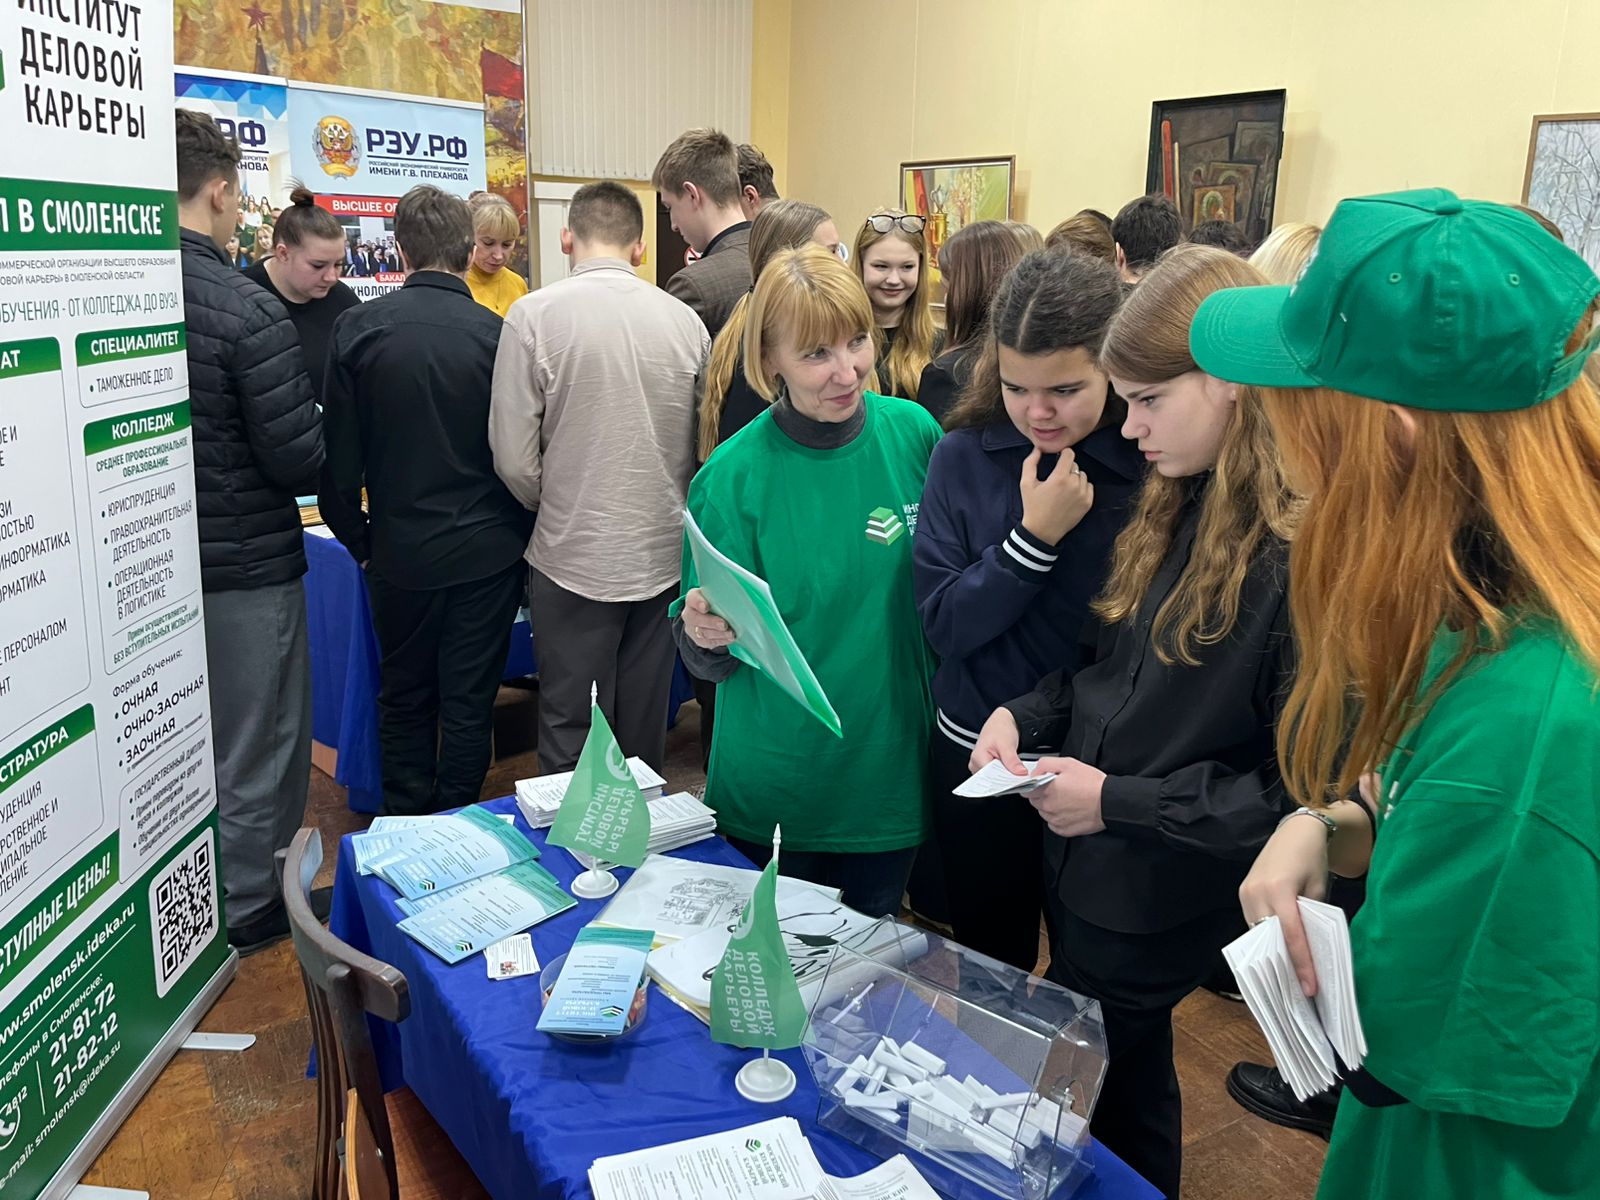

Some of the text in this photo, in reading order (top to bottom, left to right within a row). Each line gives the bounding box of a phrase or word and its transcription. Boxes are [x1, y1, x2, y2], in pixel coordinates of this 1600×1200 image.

[18, 0, 141, 41] СТИТУТ
[20, 26, 143, 91] ДЕЛОВОЙ
[24, 83, 145, 139] КАРЬЕРЫ
[366, 128, 468, 160] РЭУ.РФ
[369, 166, 469, 181] ИМЕНИ Г.В. ПЛЕХАНОВА
[18, 198, 35, 232] В
[332, 200, 383, 212] ВЫСШЕЕ
[57, 258, 103, 268] ОРГАНИЗАЦИИ
[104, 257, 137, 267] ВЫСШЕГО
[137, 257, 177, 266] ОБРАЗОВАНИЯ
[65, 272, 69, 283] В
[70, 270, 113, 282] СМОЛЕНСКОЙ
[114, 270, 145, 280] ОБЛАСТИ
[0, 299, 60, 324] БУЧЕНИЯ
[68, 298, 81, 318] ОТ
[83, 294, 142, 316] КОЛЛЕДЖА
[143, 292, 158, 314] ДО
[159, 291, 179, 310] ВУЗА
[91, 330, 179, 356] СПЕЦИАЛИТЕТ
[96, 366, 173, 393] ТАМОЖЕННОЕ ДЕЛО
[111, 412, 175, 440] КОЛЛЕДЖ
[96, 436, 188, 472] СРЕДНЕЕ ПРОФЕССИОНАЛЬНОЕ
[122, 456, 169, 477] ОБРАЗОВАНИЕ
[108, 482, 176, 517] ЮРИСПРУДЕНЦИЯ
[0, 514, 34, 541] ОСТЬЮ
[110, 500, 192, 543] ПРАВООХРАНИТЕЛЬНАЯ
[113, 527, 171, 564] ДЕЯТЕЛЬНОСТЬ
[114, 549, 174, 586] ОПЕРАЦИОННАЯ
[117, 567, 174, 606] ДЕЯТЕЛЬНОСТЬ
[117, 585, 167, 621] В ЛОГИСТИКЕ
[4, 618, 67, 662] ПЕРСОНАЛОМ
[113, 649, 125, 664] БЕЗ
[125, 623, 170, 658] ВСТУПИТЕЛЬНЫХ
[113, 649, 183, 698] Форма обучения:
[121, 681, 159, 716] ОЧНАЯ
[123, 675, 204, 739] ОЧНО-ЗАОЧНАЯ
[126, 717, 176, 763] ЗАОЧНАЯ
[0, 797, 59, 856] РСТВЕННОЕ И
[0, 825, 47, 879] ИПАЛЬНОЕ
[67, 852, 111, 909] ЦЕНЫ!
[42, 1031, 49, 1043] в
[50, 973, 103, 1033] Смоленске:
[724, 948, 744, 1034] КАРЬЕРЫ
[732, 948, 763, 1035] ДЕЛОВОЙ
[746, 951, 776, 1037] КОЛЛЕДЖ
[49, 982, 115, 1067] 21-81-72
[53, 1012, 119, 1098] 21-82-12
[5, 1085, 28, 1117] 4812
[35, 1041, 121, 1147] smolensk@ideka.su
